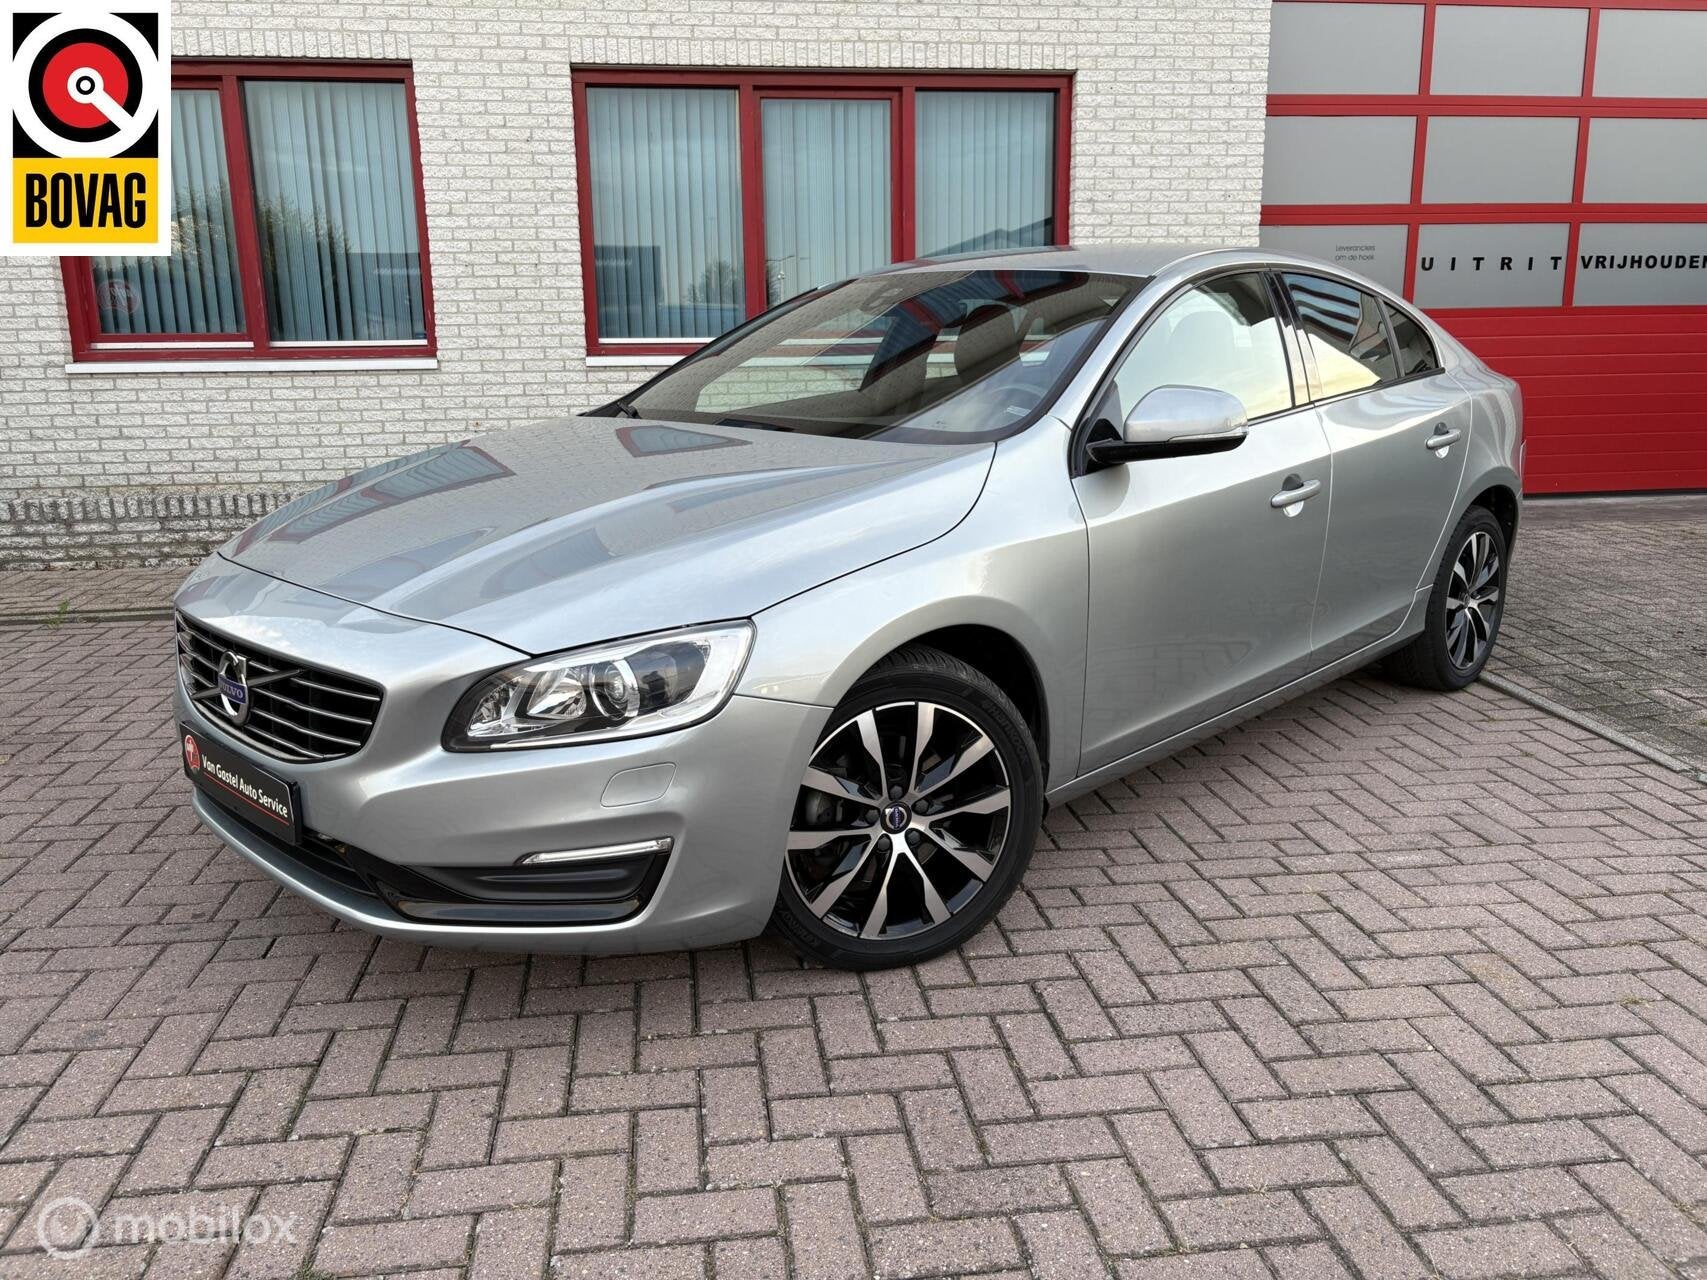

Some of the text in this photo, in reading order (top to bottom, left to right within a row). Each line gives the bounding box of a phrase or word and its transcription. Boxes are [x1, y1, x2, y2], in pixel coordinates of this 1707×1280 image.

[202, 754, 288, 818] Van Gastel Auto Service
